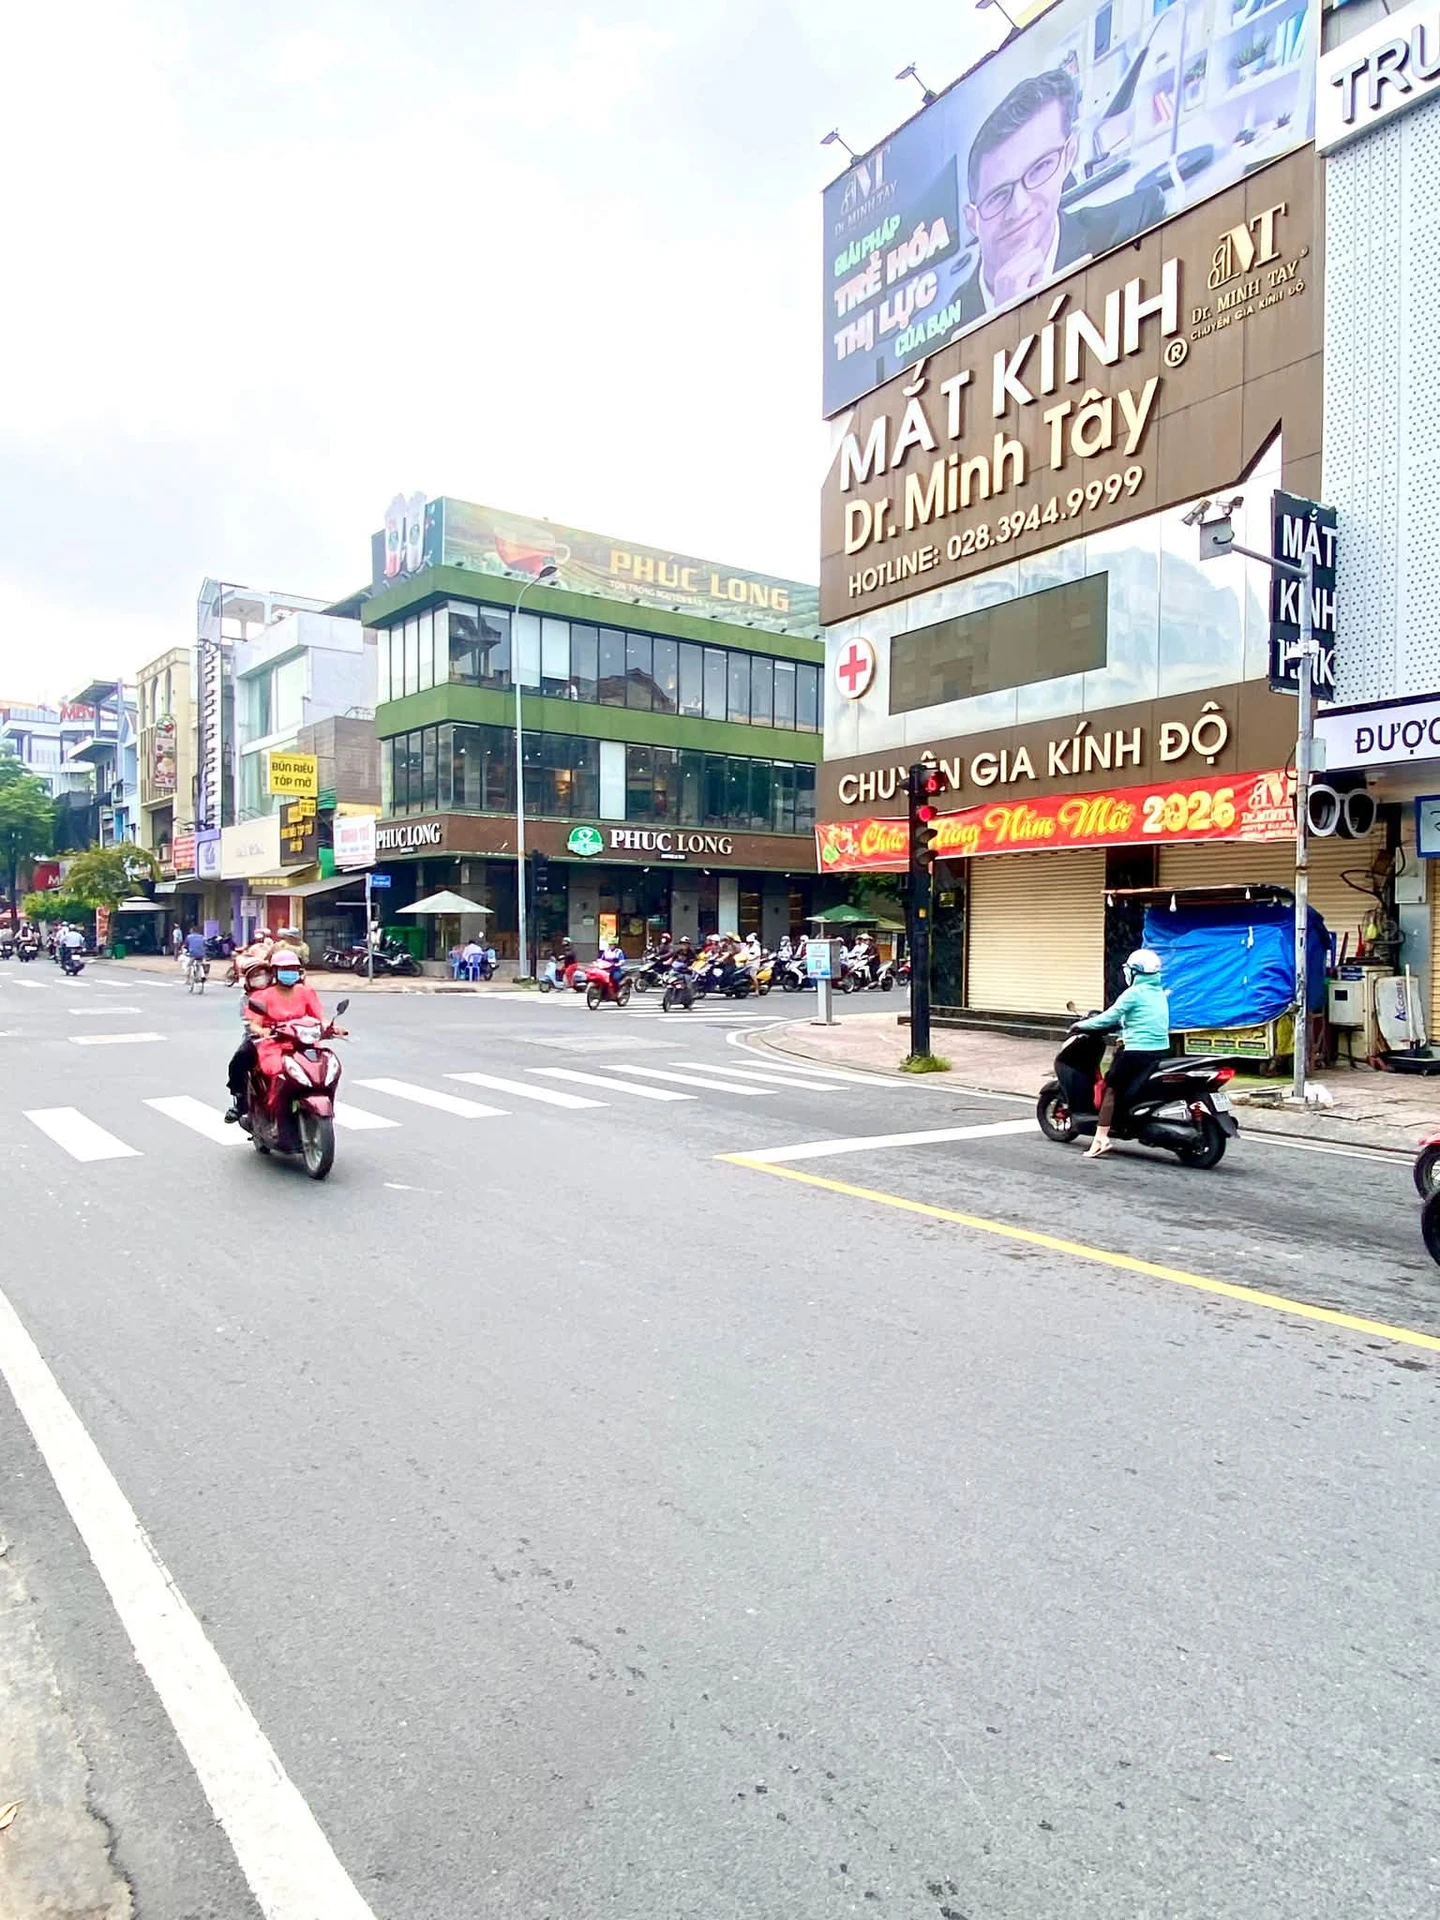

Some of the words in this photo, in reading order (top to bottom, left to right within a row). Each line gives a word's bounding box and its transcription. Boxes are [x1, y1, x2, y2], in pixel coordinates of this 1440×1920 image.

[861, 213, 901, 258] PHÁP
[833, 249, 882, 318] TRẺ
[886, 216, 950, 286] HÓA
[833, 308, 875, 361] THỊ
[878, 270, 938, 335] LỰC
[926, 299, 962, 336] BẠN
[1191, 307, 1211, 326] Dr.
[1217, 277, 1261, 313] MINH
[1235, 307, 1255, 320] GIA
[839, 357, 974, 492] MẮT
[992, 257, 1180, 419] KÍNH
[844, 496, 896, 556] Dr.
[904, 431, 1026, 532] Minh
[1043, 375, 1162, 472] Tây
[848, 545, 940, 598] HOTLINE:
[946, 465, 1144, 561] 028.3944.9999
[1282, 508, 1337, 568] MẮT
[709, 572, 789, 613] LONG
[1279, 578, 1337, 632] KNH
[838, 750, 961, 805] CHUN
[970, 746, 1036, 788] GIA
[1048, 721, 1142, 777] KÍNH
[1159, 700, 1229, 766] ĐỘ
[375, 827, 407, 850] PHUC
[407, 823, 441, 846] LONG
[610, 829, 672, 852] PHUC
[677, 834, 733, 855] LONG
[984, 804, 1055, 843] Năm
[1057, 796, 1136, 839] Mới
[1142, 787, 1237, 834] 2026
